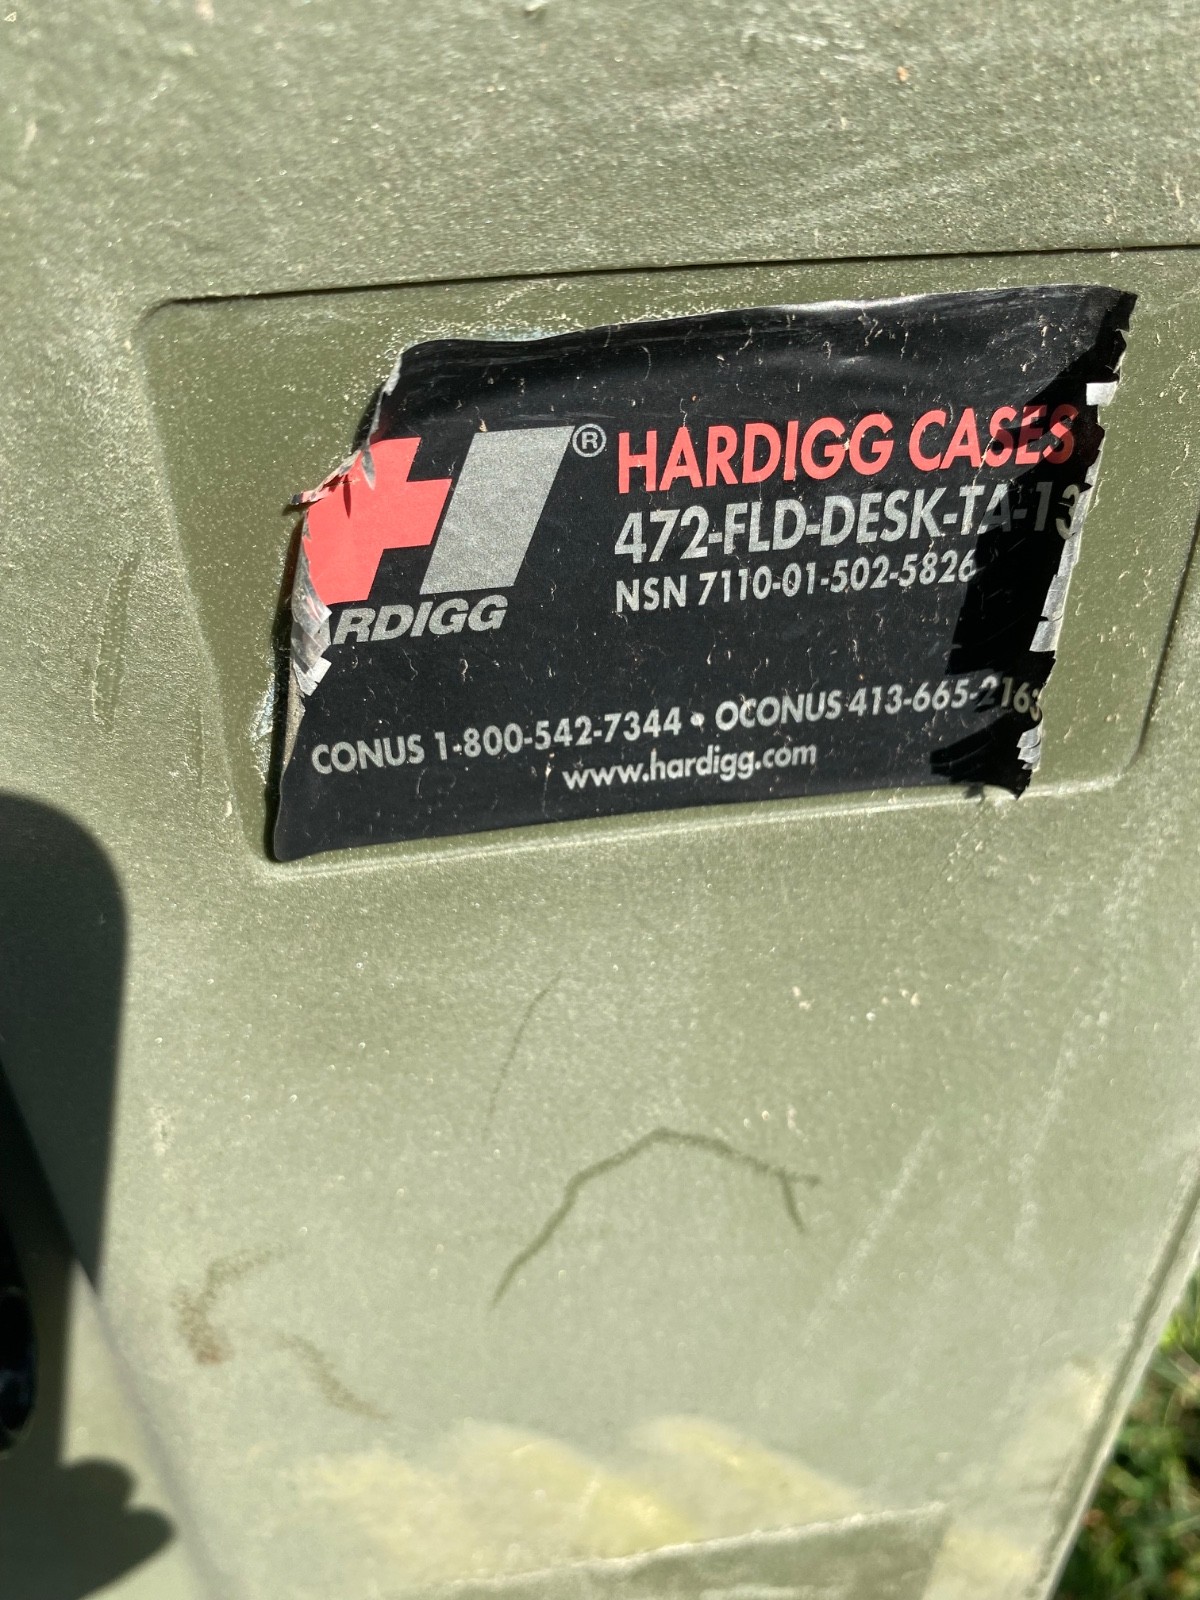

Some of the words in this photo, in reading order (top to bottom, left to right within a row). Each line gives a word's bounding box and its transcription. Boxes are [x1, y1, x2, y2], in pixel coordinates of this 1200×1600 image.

[617, 414, 894, 495] HARDIGG
[909, 403, 1080, 472] CASES
[615, 574, 688, 613] NSN
[698, 548, 977, 605] 7110-01-502-5826
[311, 734, 425, 775] CONUS
[434, 706, 682, 762] 1-800-542-7344
[714, 689, 842, 732] OCONUS
[562, 743, 818, 791] www.hardigg.com
